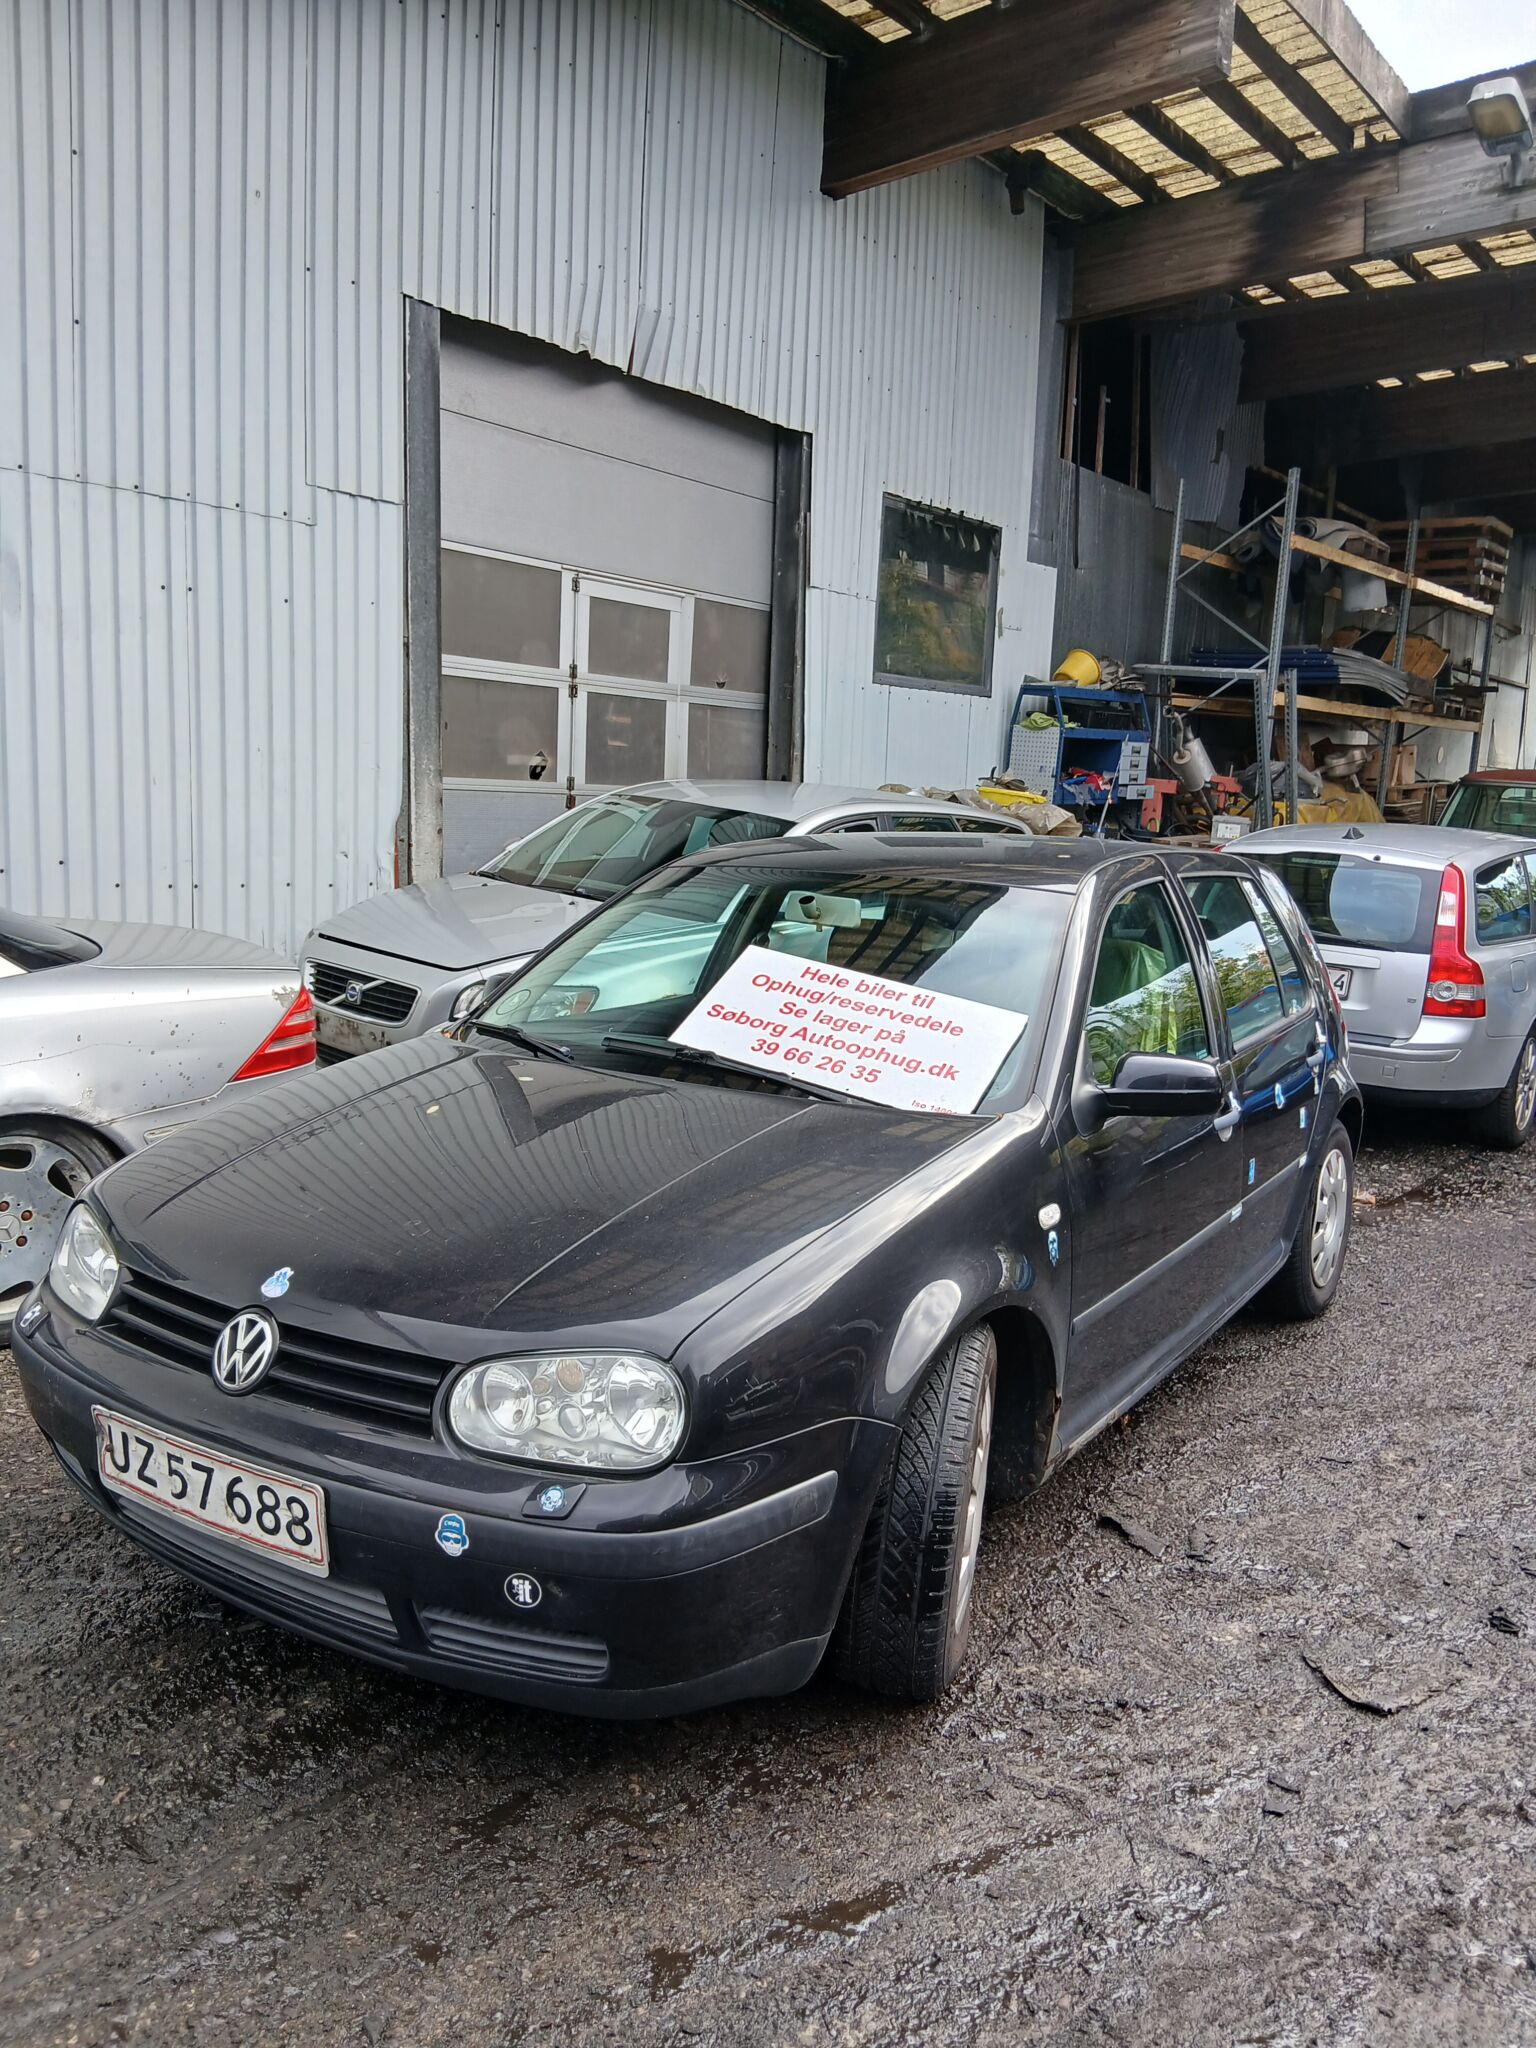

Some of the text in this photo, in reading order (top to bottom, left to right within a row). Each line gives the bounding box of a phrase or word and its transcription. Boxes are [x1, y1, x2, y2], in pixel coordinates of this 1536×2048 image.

[751, 974, 964, 1037] Ophug/reservedele
[800, 966, 936, 1009] Hele biler til
[706, 1004, 961, 1081] Søborg Autoophug.dk
[779, 1001, 906, 1045] Se lager på
[750, 1038, 882, 1083] 39 66 26 35
